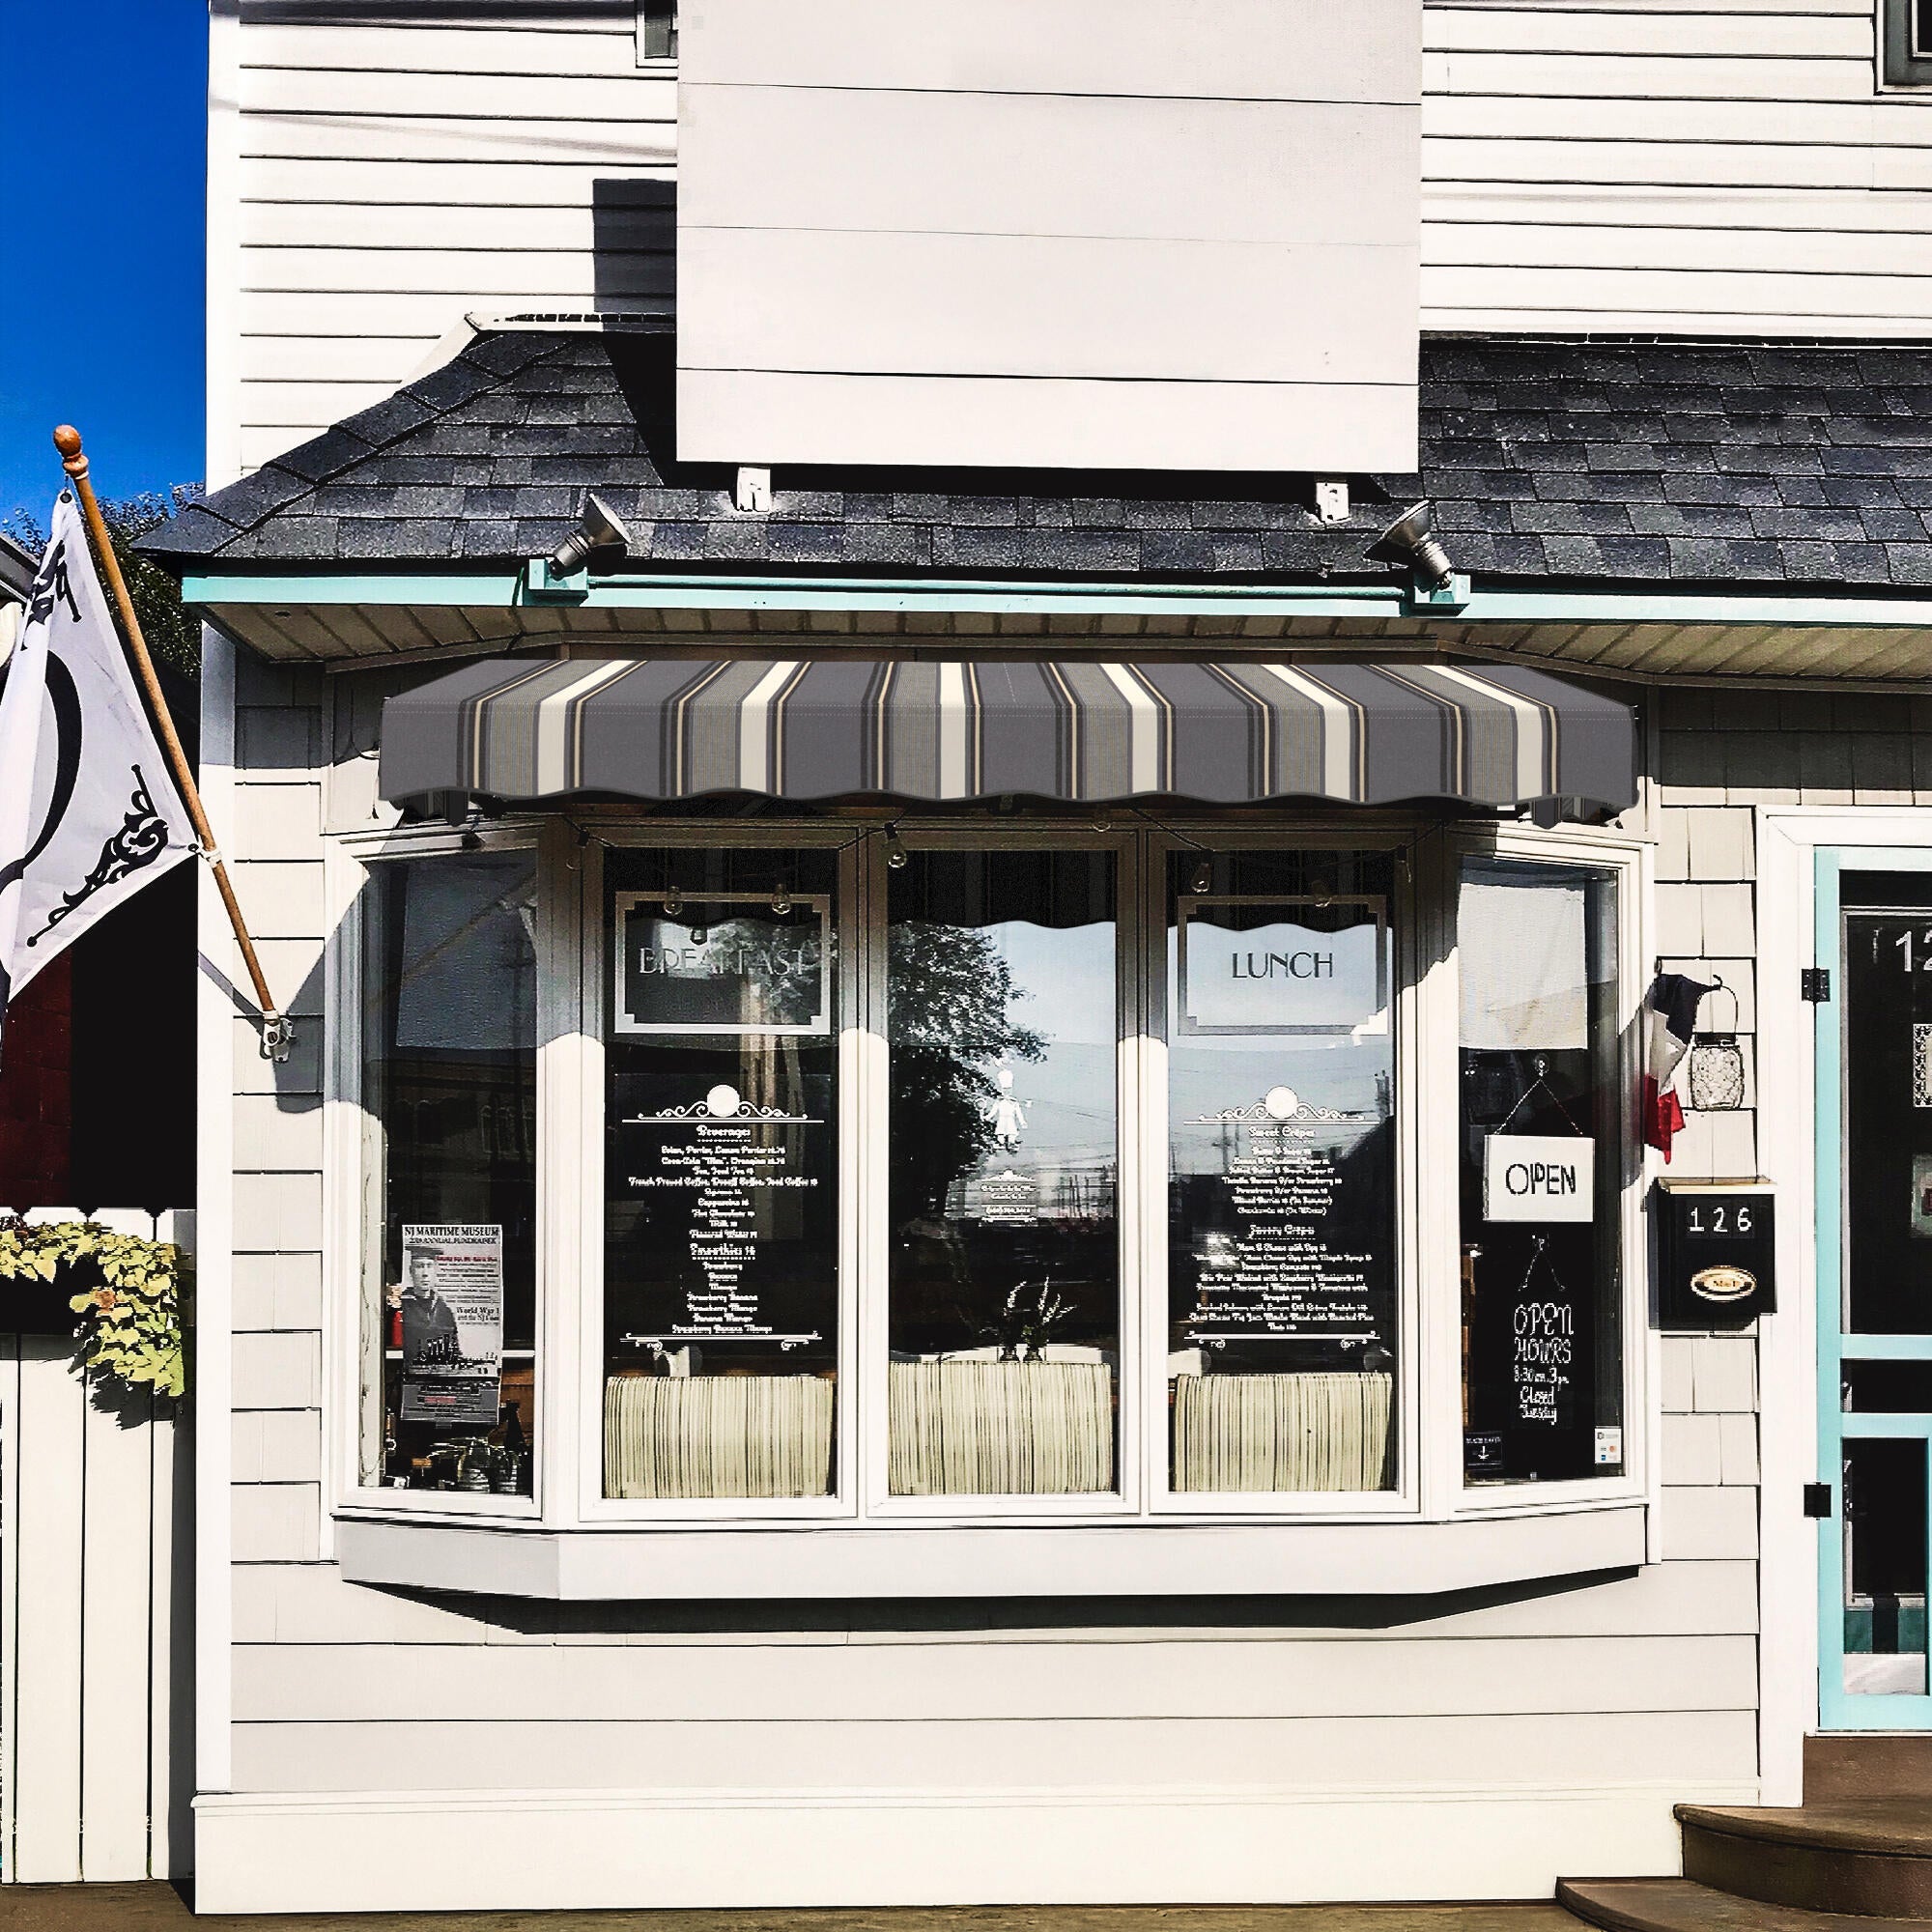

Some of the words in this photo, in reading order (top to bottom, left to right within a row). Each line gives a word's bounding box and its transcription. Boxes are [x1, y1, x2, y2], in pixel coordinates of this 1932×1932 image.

[1895, 930, 1932, 972] 1
[1232, 952, 1333, 979] LUNCH
[1505, 1161, 1577, 1195] OPEN
[416, 1226, 459, 1236] MARITIME
[462, 1226, 498, 1236] MUSEUM
[1689, 1207, 1752, 1233] 126
